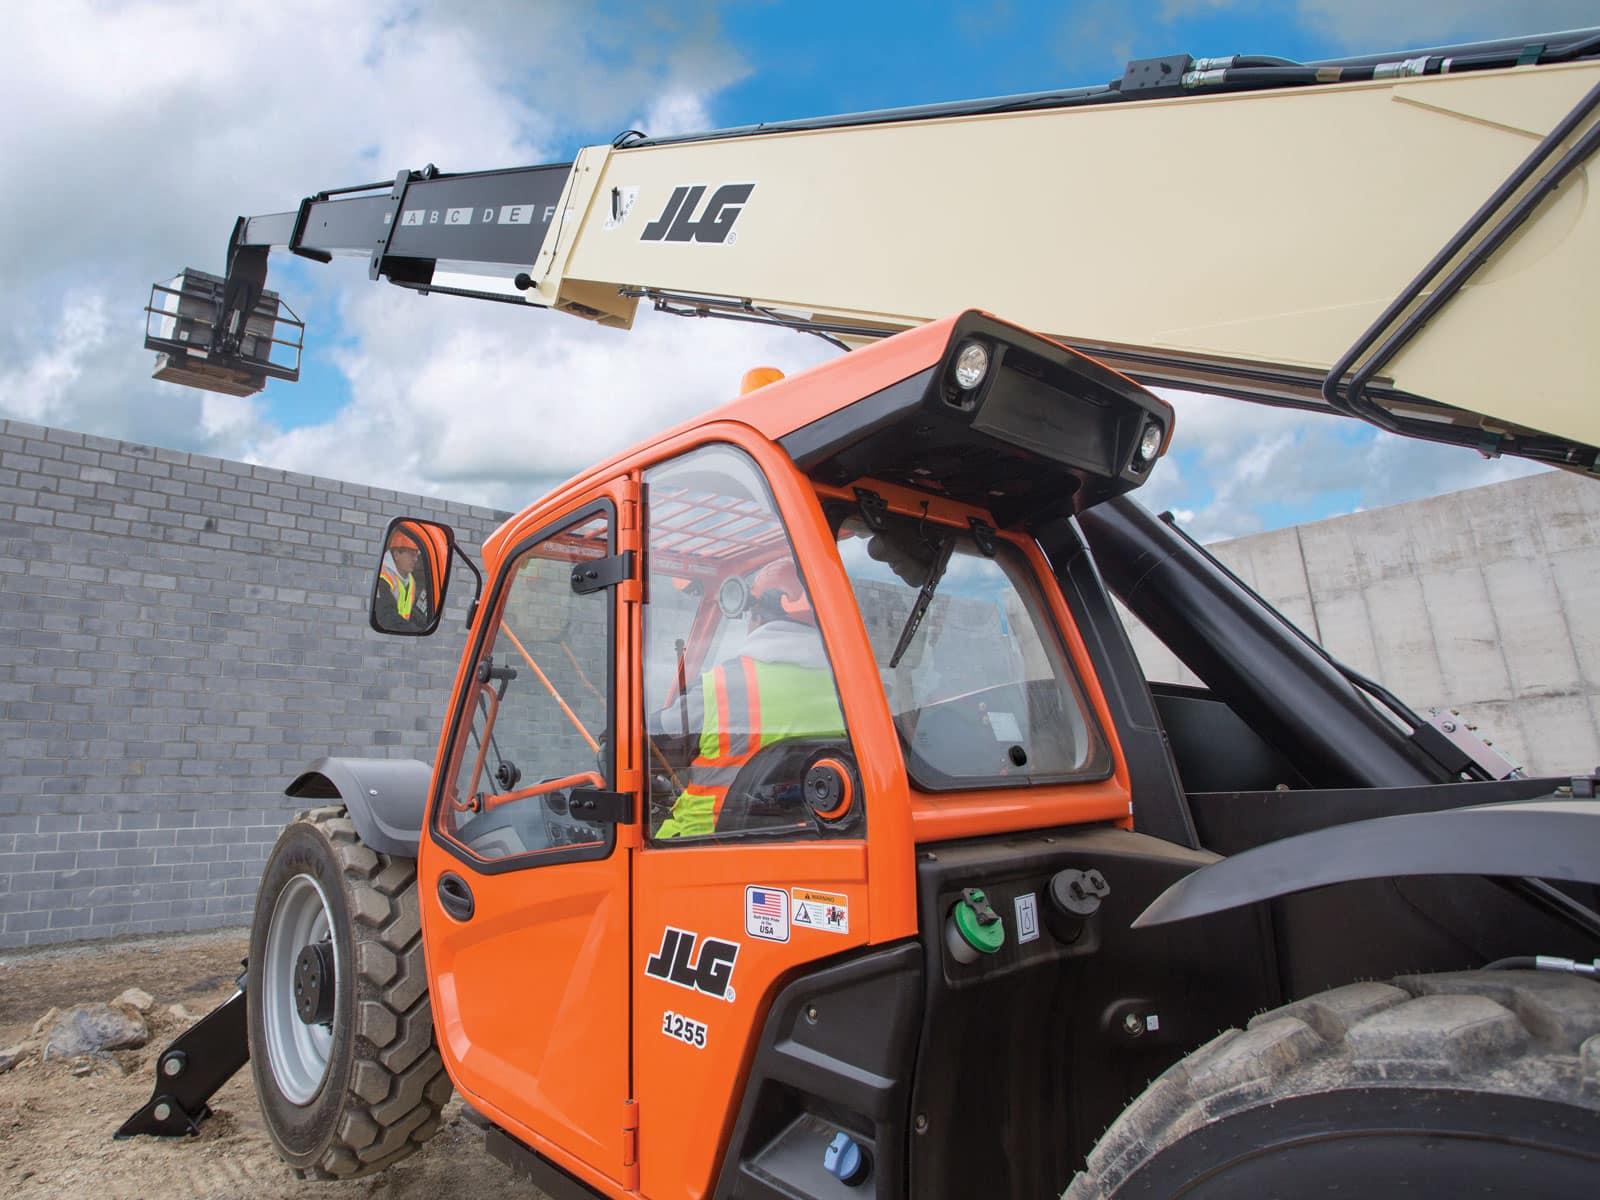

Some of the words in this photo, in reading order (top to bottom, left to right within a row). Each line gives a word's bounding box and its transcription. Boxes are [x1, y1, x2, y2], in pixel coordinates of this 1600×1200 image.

[408, 212, 417, 224] A
[429, 210, 439, 224] B
[451, 210, 461, 223] C
[482, 208, 494, 223] D
[509, 207, 522, 222] E
[542, 206, 556, 223] F
[640, 183, 756, 243] JLG
[759, 925, 774, 935] USA
[646, 929, 740, 998] JLG
[664, 1014, 706, 1046] 1255
